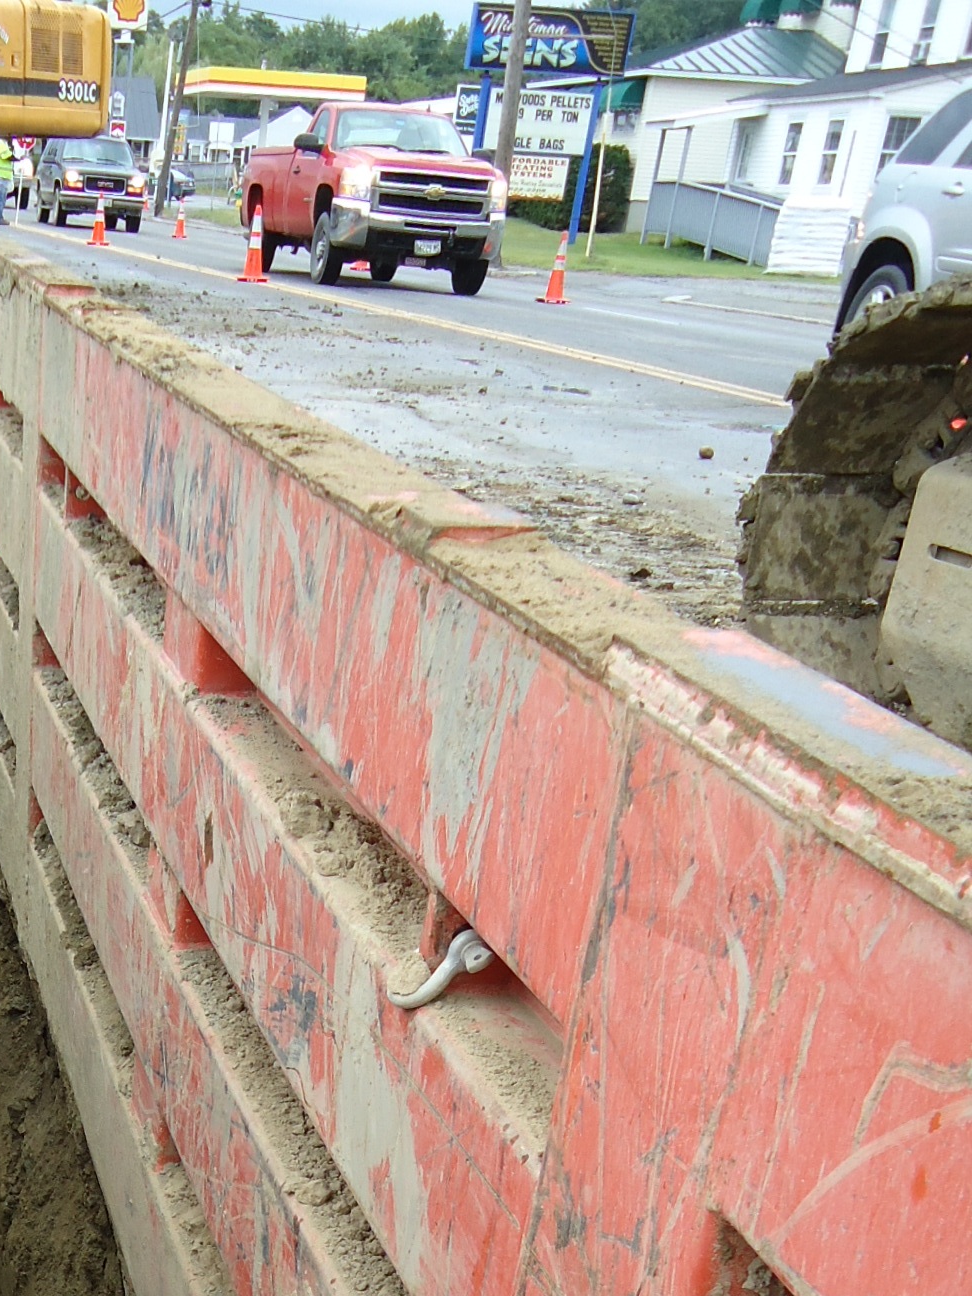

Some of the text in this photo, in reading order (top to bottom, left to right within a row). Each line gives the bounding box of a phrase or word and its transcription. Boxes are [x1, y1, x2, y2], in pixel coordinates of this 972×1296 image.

[481, 11, 566, 36] Minteman
[58, 79, 97, 103] 330LC
[550, 95, 591, 109] PELLETS
[535, 109, 553, 121] PER
[561, 110, 579, 123] TON
[539, 138, 565, 151] BAGS
[514, 170, 552, 178] YSTEMS
